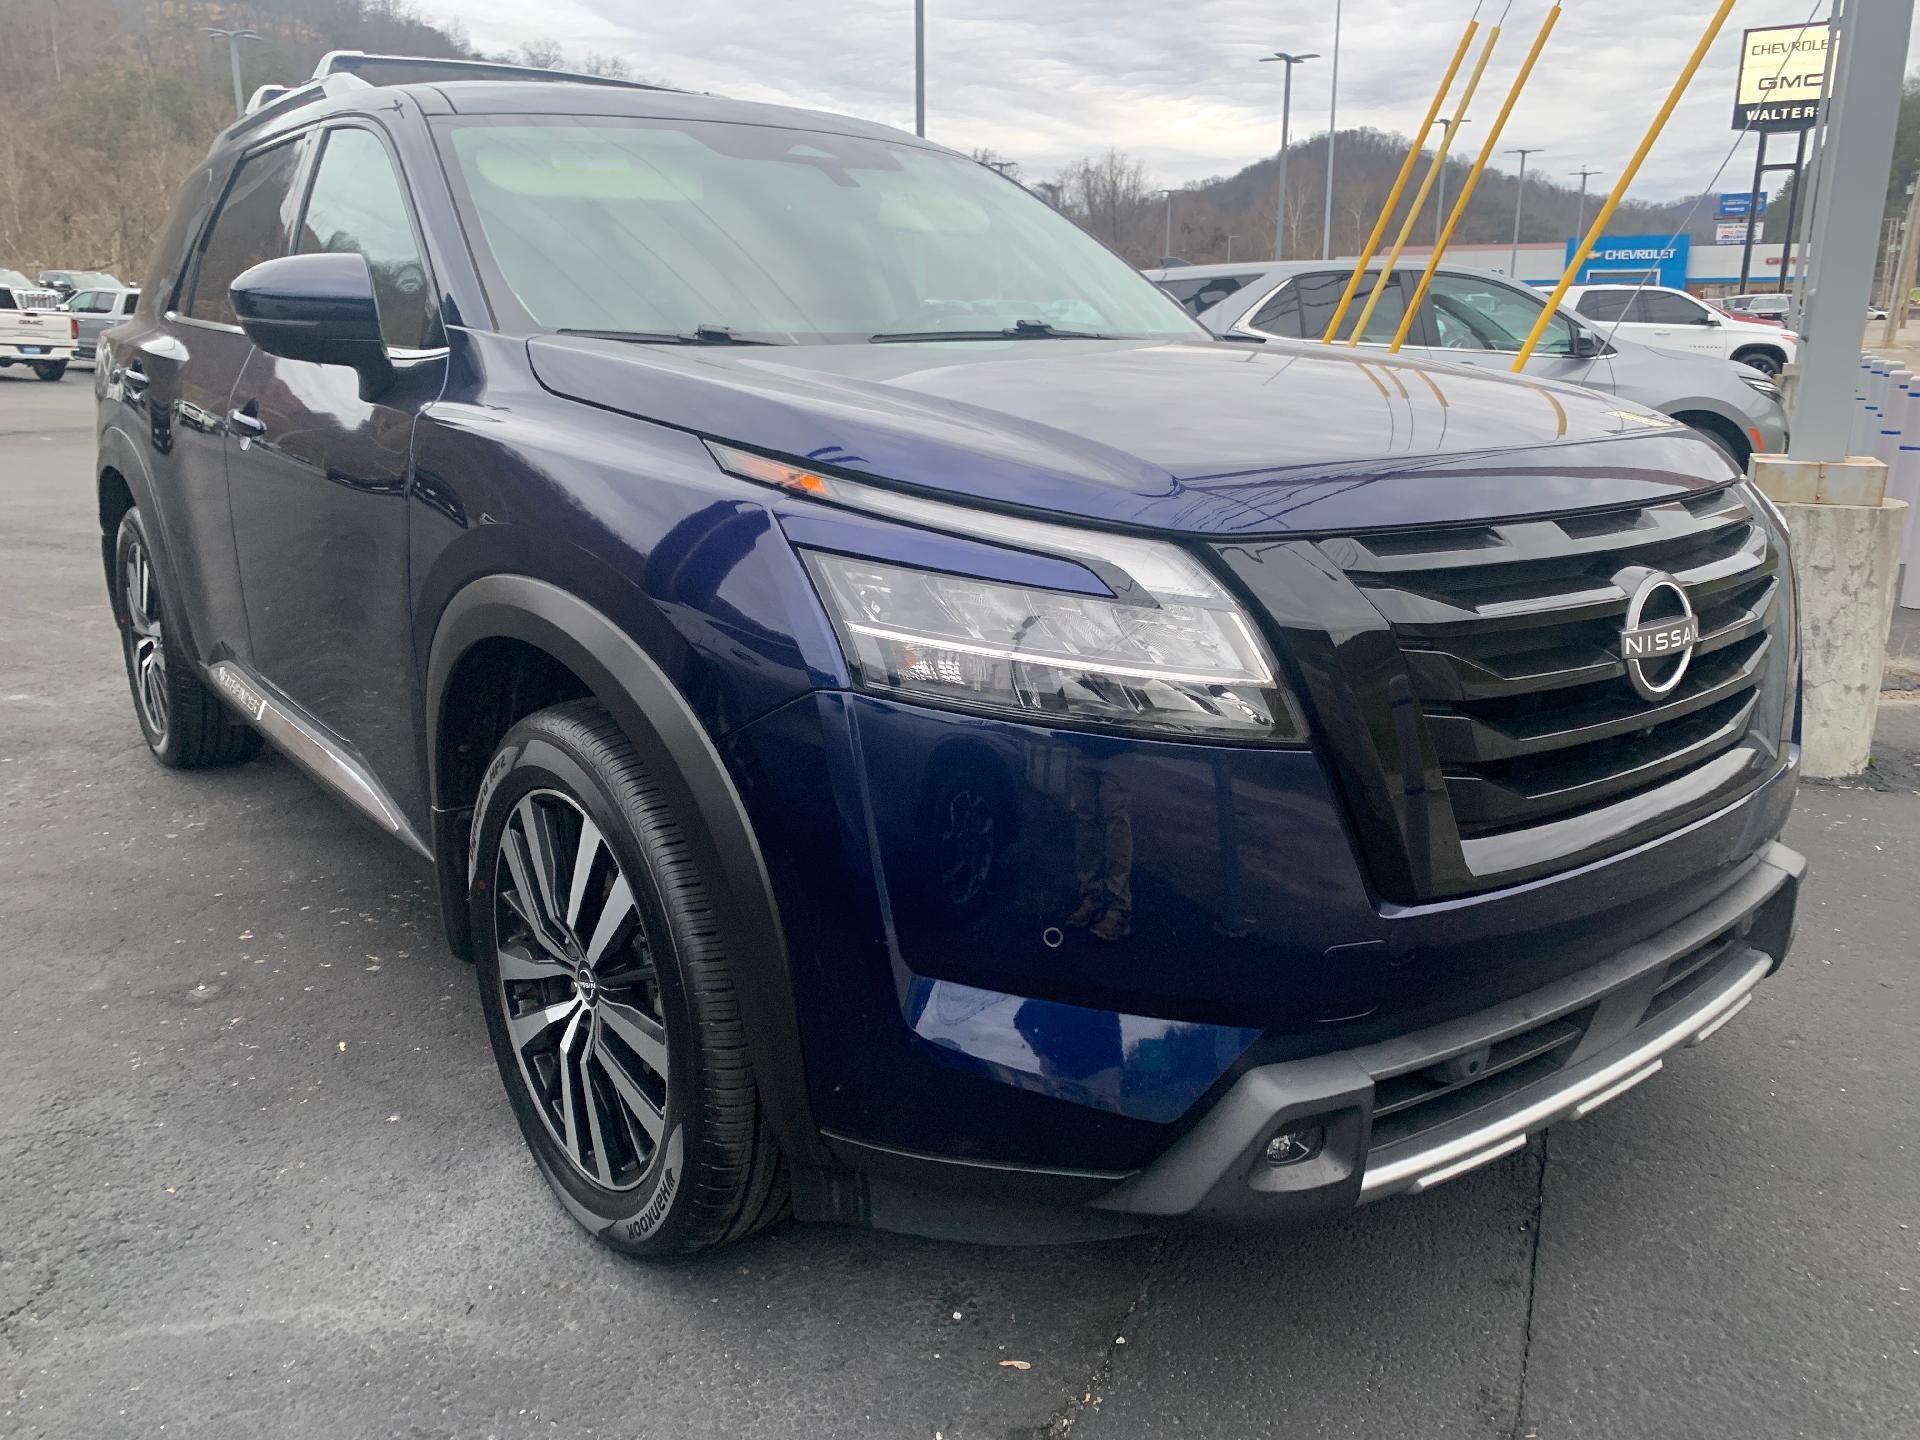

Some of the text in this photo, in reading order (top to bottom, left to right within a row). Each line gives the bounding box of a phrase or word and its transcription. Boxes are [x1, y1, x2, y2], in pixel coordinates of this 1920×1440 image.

[1751, 39, 1830, 56] CHEVROLE
[1758, 73, 1824, 90] GMC
[1746, 106, 1820, 121] WALTER
[1605, 249, 1676, 260] CHEVROLET
[1626, 624, 1698, 655] NISSAN
